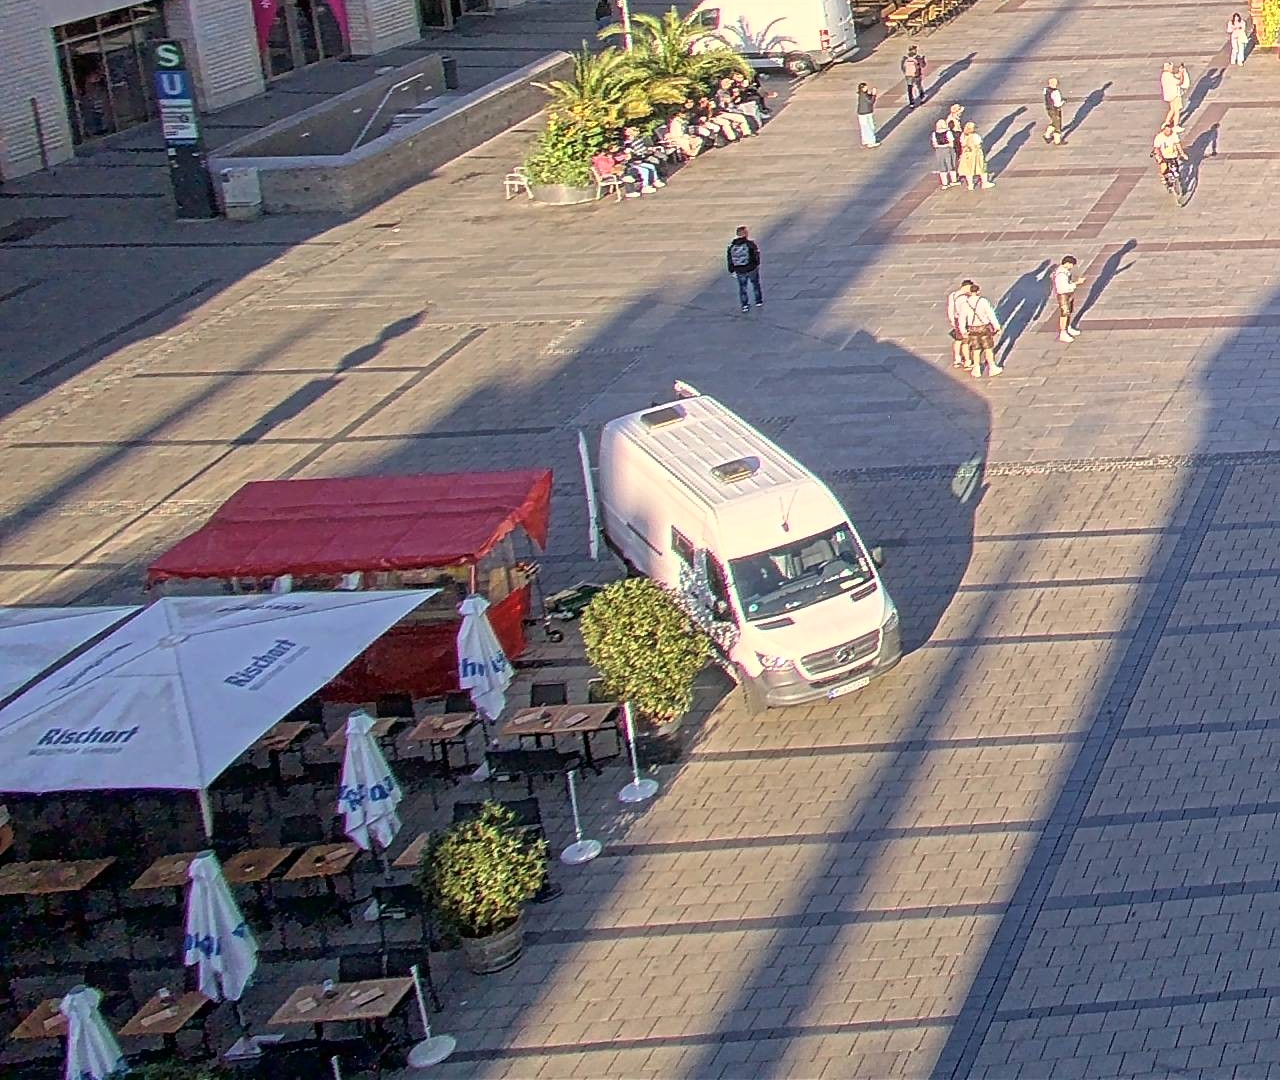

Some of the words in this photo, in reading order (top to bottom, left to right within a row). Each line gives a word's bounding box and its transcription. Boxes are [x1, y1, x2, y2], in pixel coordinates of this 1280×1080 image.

[157, 44, 180, 68] S
[160, 73, 183, 96] U
[223, 639, 297, 688] Rischart
[37, 724, 141, 746] Rischart
